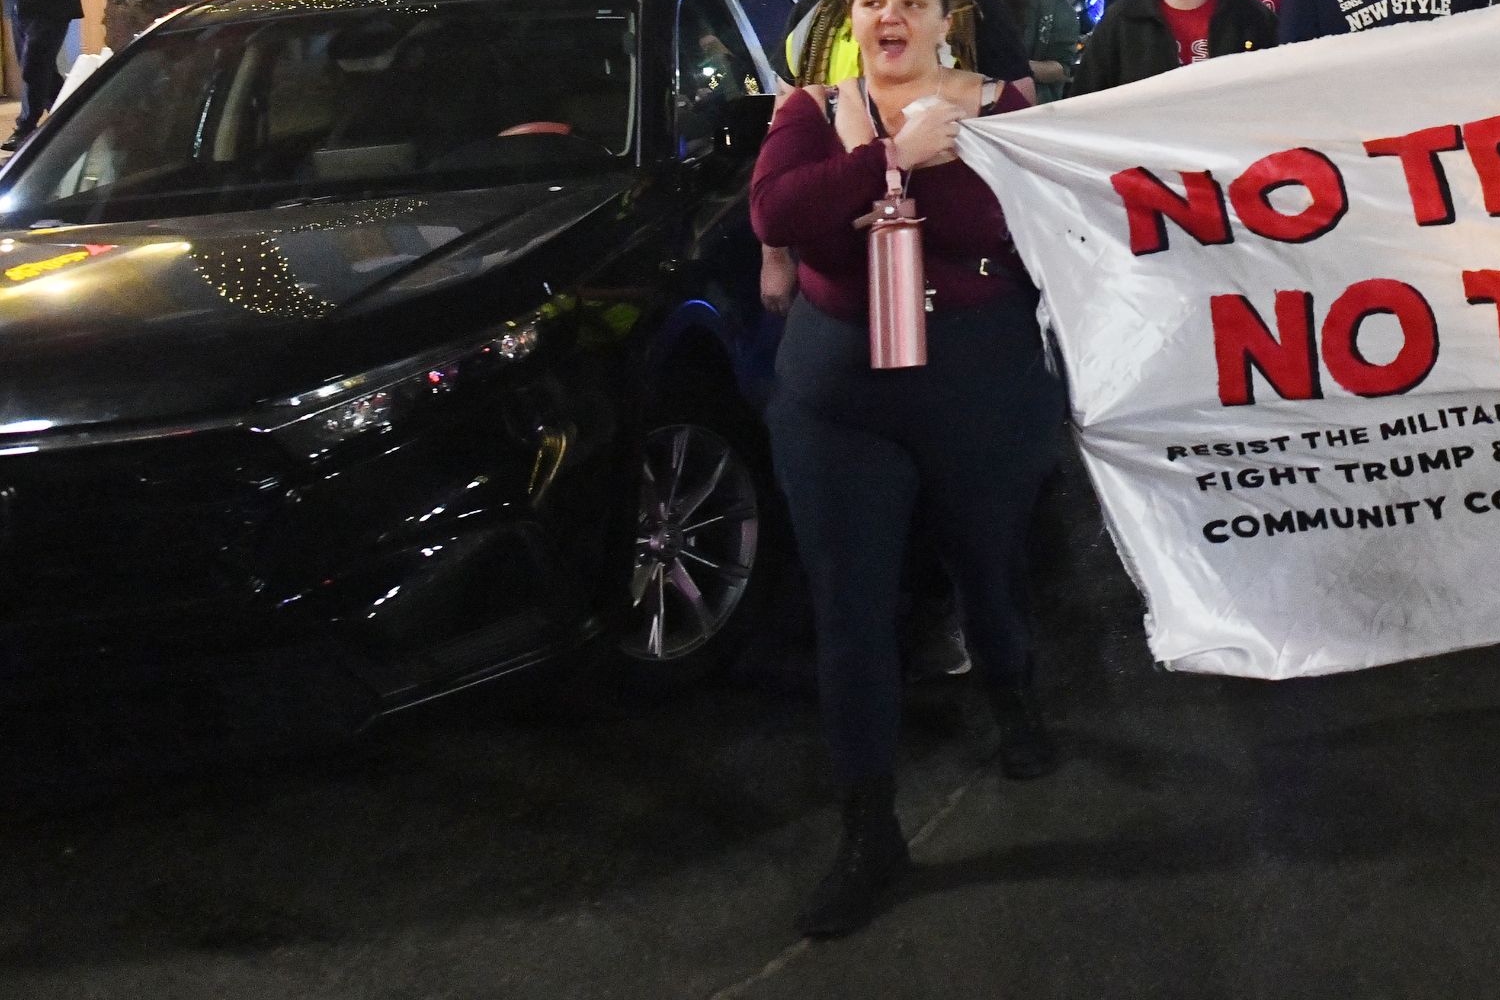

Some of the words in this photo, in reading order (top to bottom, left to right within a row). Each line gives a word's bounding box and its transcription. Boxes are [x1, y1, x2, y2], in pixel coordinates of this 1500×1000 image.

[1344, 0, 1389, 33] NEW
[1110, 146, 1348, 256] NO
[1210, 277, 1439, 407] NO
[1166, 435, 1290, 462] RESIST
[1301, 427, 1370, 450] THE
[1196, 466, 1321, 491] FIGHT
[1334, 445, 1475, 484] TRUMP
[1202, 495, 1446, 544] COMMUNITY
